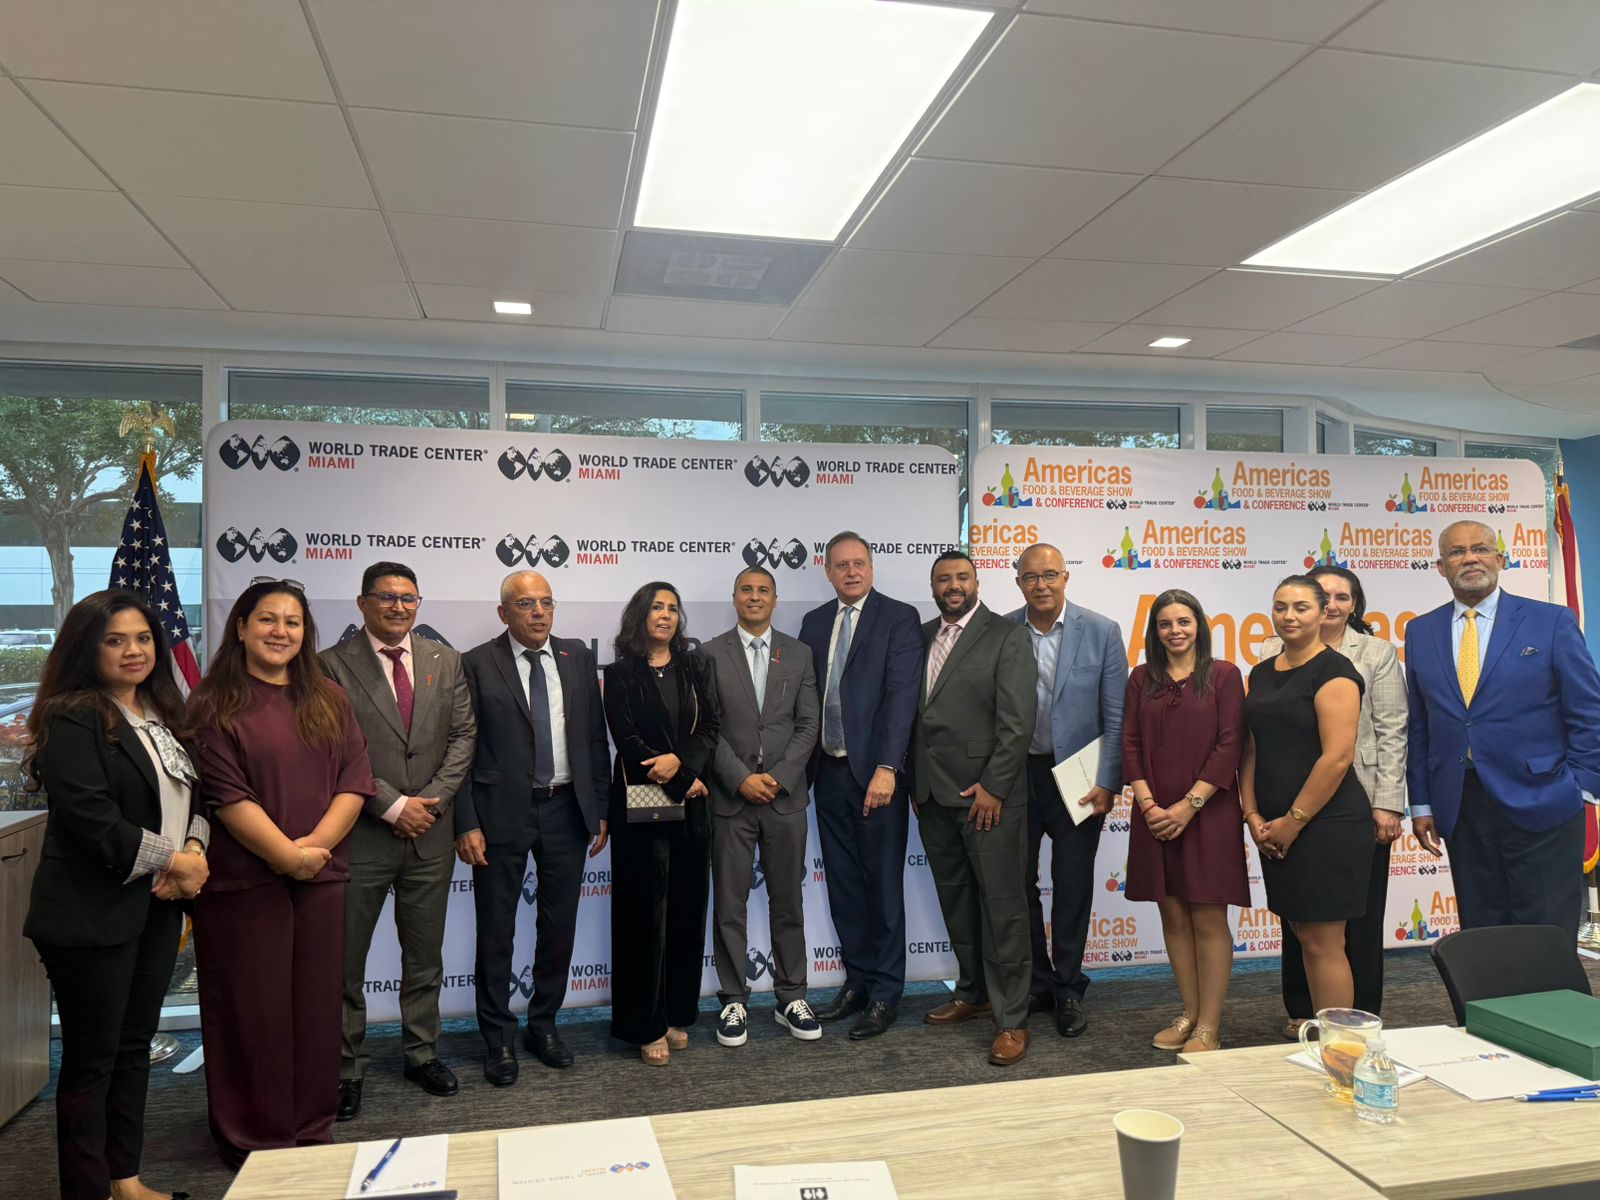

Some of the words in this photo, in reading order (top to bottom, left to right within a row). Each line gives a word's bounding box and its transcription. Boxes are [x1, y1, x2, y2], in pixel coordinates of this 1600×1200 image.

[309, 441, 364, 456] WORLD
[369, 444, 419, 459] TRADE
[308, 456, 355, 469] MIAMI
[579, 454, 628, 468] WORLD
[633, 456, 677, 469] TRADE
[816, 460, 861, 473] WORLD
[865, 461, 905, 474] TRADE
[578, 468, 621, 480] MIAMI
[1023, 457, 1132, 485] Americas
[1232, 461, 1331, 488] Americas
[816, 473, 854, 485] MIAMI
[1419, 466, 1509, 491] Americas
[1022, 484, 1047, 495] FOOD
[1050, 485, 1057, 496] &
[1059, 485, 1105, 497] BEVERAGE
[1107, 486, 1133, 497] SHOW
[1232, 487, 1256, 498] FOOD
[1257, 488, 1264, 499] &
[1265, 487, 1307, 499] BEVERAGE
[1308, 488, 1332, 500] SHOW
[1419, 491, 1441, 501] FOOD
[1442, 491, 1448, 501] &
[1449, 491, 1486, 502] BEVERAGE
[1488, 492, 1510, 502] SHOW
[1035, 497, 1043, 508] &
[1045, 497, 1105, 509] CONFERENCE
[1243, 500, 1250, 510] &
[1252, 500, 1306, 511] CONFERENCE
[1430, 503, 1436, 513] &
[1437, 503, 1487, 513] CONFERENCE
[969, 518, 1039, 545] ericas
[1142, 519, 1246, 546] Americas
[1340, 522, 1433, 547] Americas
[306, 533, 362, 546] WORLD
[367, 534, 417, 548] TRADE
[577, 540, 626, 552] WORLD
[631, 541, 675, 553] TRADE
[305, 547, 353, 560] MIAMI
[870, 542, 902, 554] RADE
[970, 546, 1011, 557] EVERAGE
[1013, 546, 1024, 557] SH
[1142, 546, 1165, 557] FOOD
[1168, 546, 1174, 557] &
[1176, 546, 1220, 557] BEVERAGE
[1222, 547, 1247, 557] SHOW
[1339, 548, 1362, 558] FOOD
[1363, 548, 1369, 558] &
[1371, 548, 1409, 558] BEVERAGE
[1411, 548, 1434, 558] SHOW
[1512, 548, 1532, 558] FOOD
[1533, 549, 1539, 558] &
[576, 553, 619, 565] MIAMI
[974, 558, 1010, 569] ERENCE
[1154, 559, 1161, 569] &
[1163, 558, 1220, 569] CONFERENCE
[1350, 559, 1357, 569] &
[1358, 559, 1409, 570] CONFERENCE
[1522, 559, 1528, 569] &
[1391, 853, 1417, 865] ERAGE
[1389, 865, 1417, 876] RENCE
[1091, 911, 1137, 938] icas
[1430, 916, 1451, 927] FOOD
[1237, 929, 1260, 940] FOOD
[1262, 928, 1269, 939] &
[1086, 938, 1109, 950] RAGE
[1111, 937, 1138, 949] SHOW
[1250, 941, 1256, 952] &
[813, 946, 843, 959] WOR
[908, 941, 953, 954] CENTE
[571, 963, 612, 977] WORL
[813, 960, 846, 972] MIA
[363, 979, 402, 994] TRAD
[442, 973, 476, 989] NTER
[571, 977, 609, 991] MIAM
